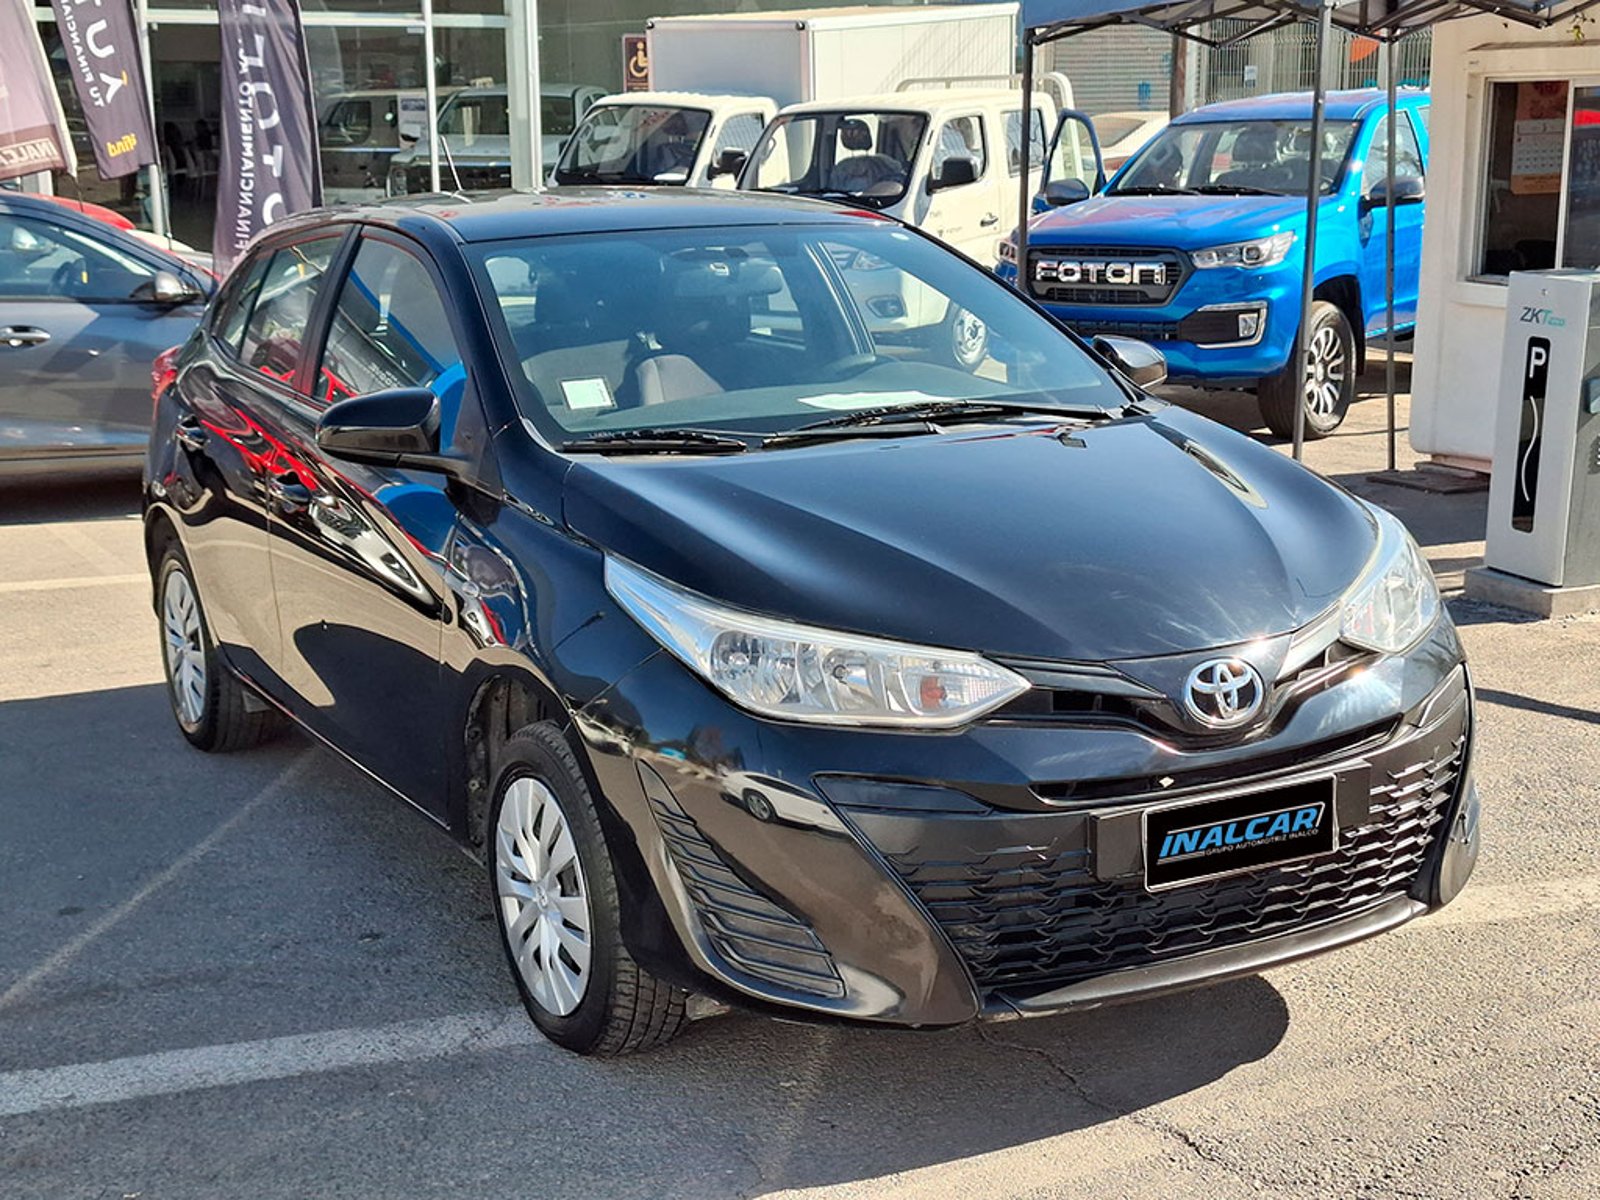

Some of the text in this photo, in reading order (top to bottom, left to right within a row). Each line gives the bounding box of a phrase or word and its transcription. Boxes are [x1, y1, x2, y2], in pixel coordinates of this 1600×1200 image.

[1036, 260, 1166, 285] FOTON
[1529, 346, 1546, 378] P
[1159, 808, 1317, 857] INALCAR
[1206, 845, 1234, 857] GRUPO
[1235, 834, 1287, 850] AUTOMOTRIZ
